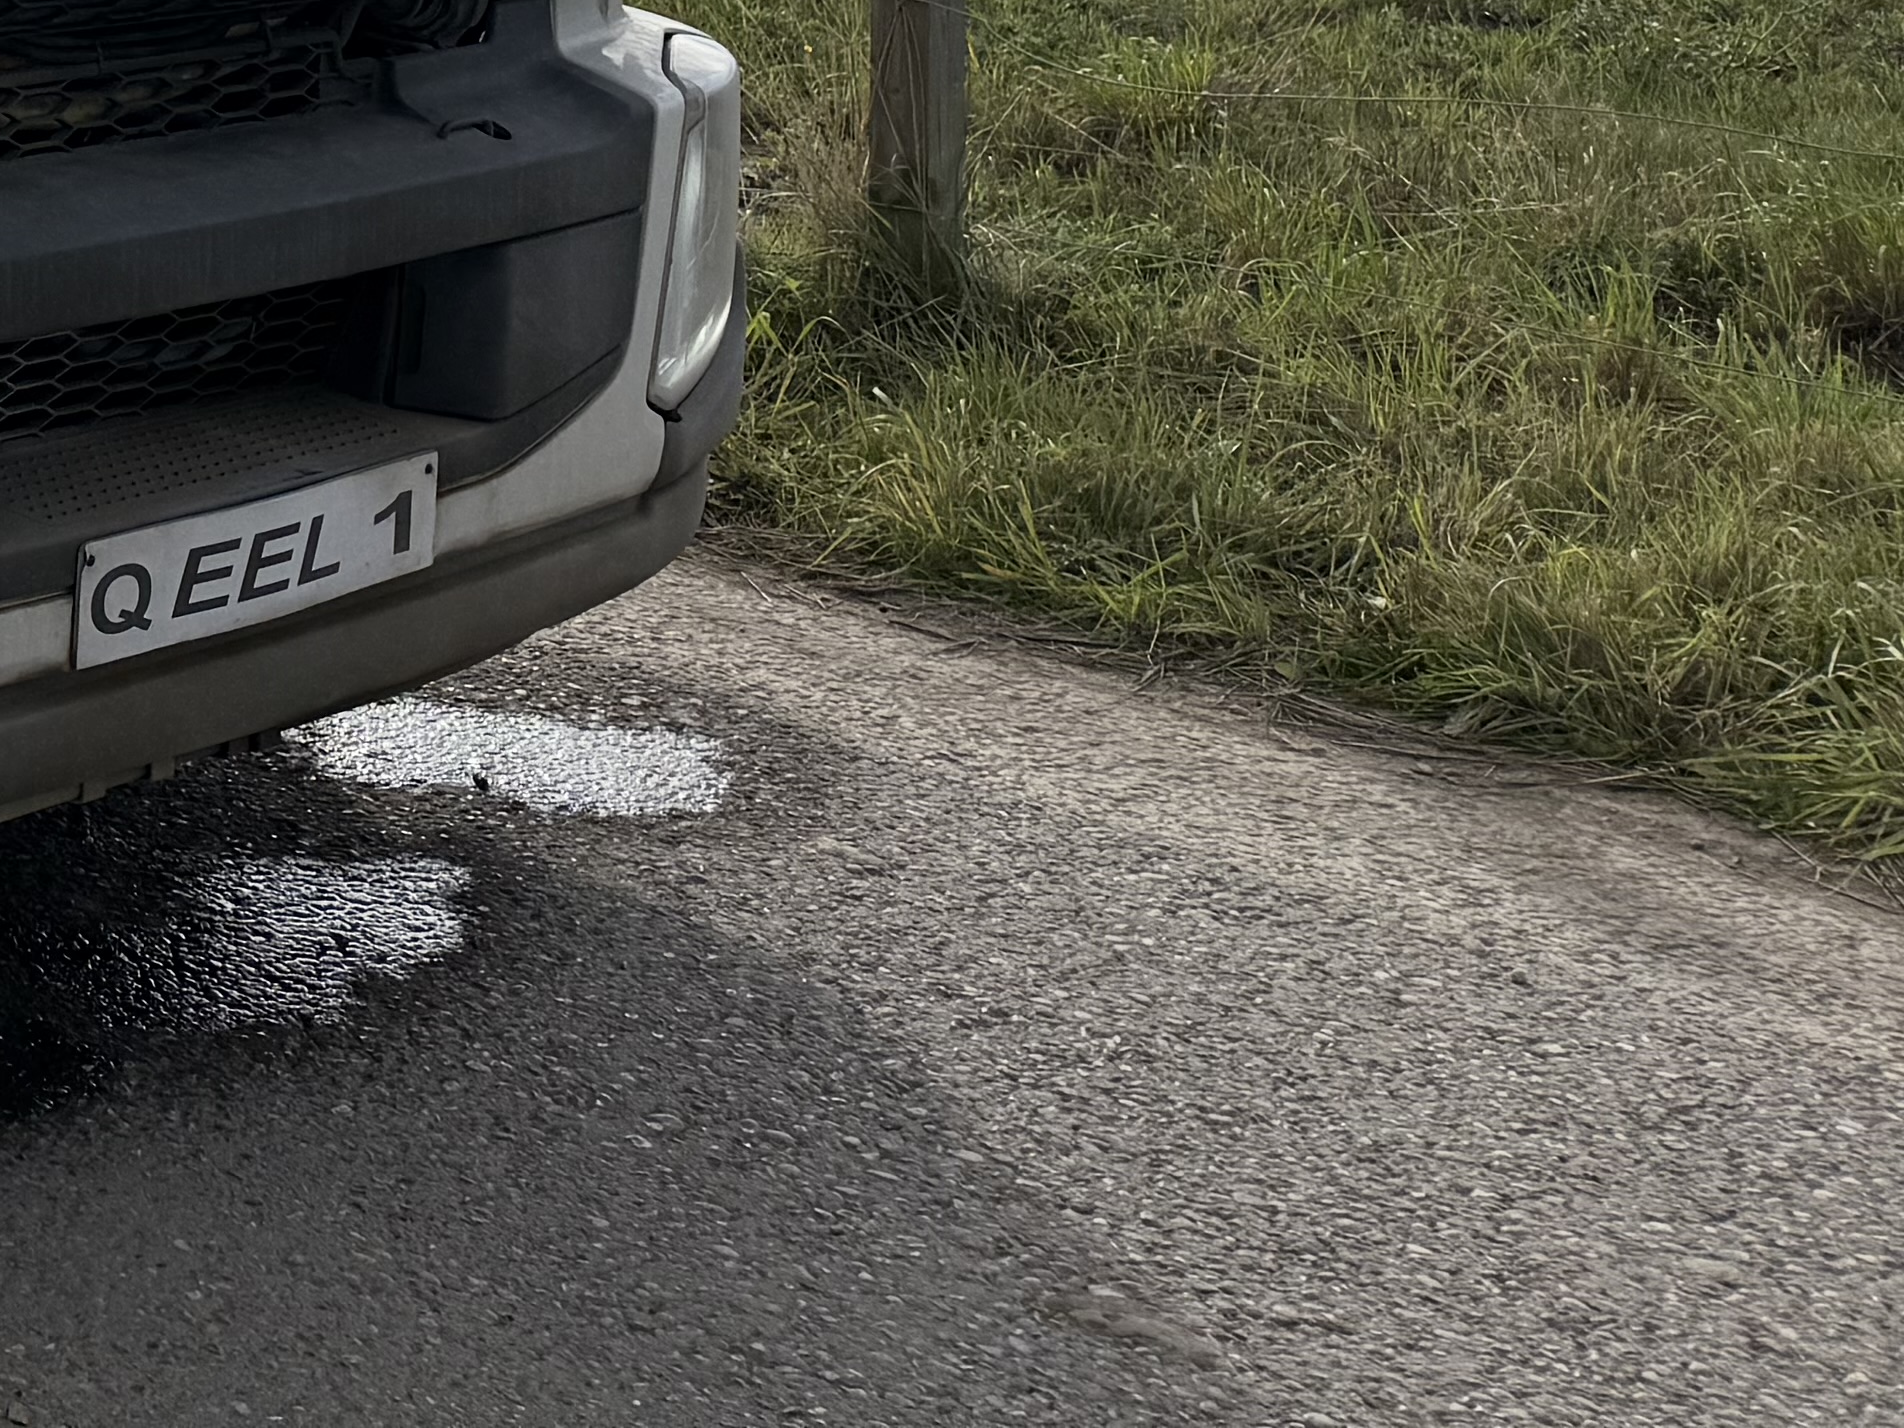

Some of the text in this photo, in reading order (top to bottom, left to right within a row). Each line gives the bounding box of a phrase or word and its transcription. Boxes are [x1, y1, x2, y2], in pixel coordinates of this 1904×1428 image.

[92, 489, 413, 634] Q EEL 1
